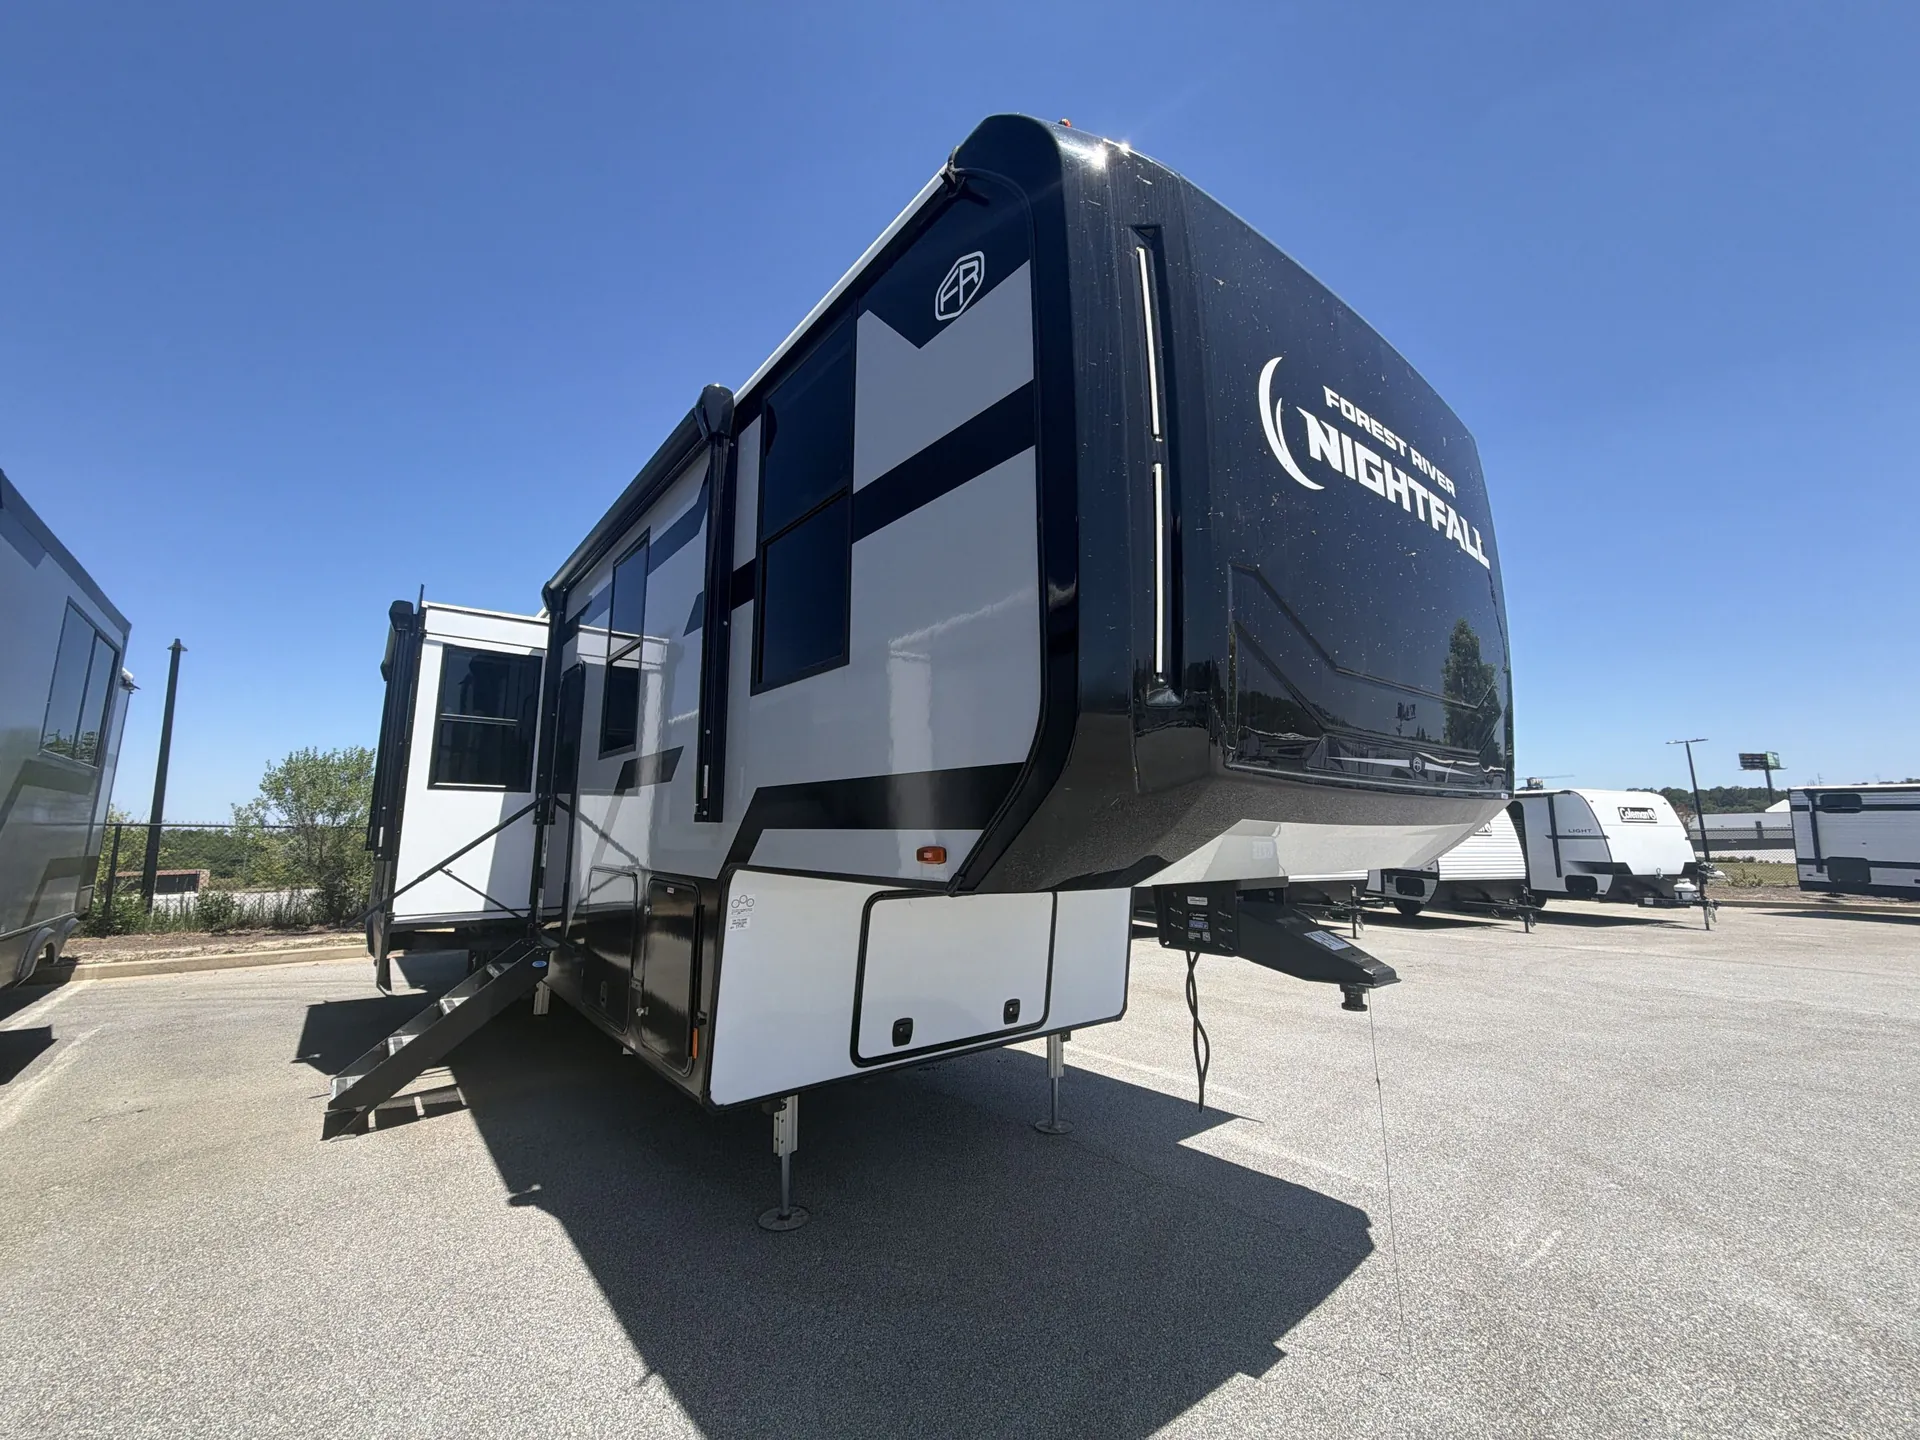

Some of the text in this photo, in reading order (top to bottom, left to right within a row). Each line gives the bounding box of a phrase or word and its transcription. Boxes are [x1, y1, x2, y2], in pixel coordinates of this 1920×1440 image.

[940, 260, 979, 312] FR
[1323, 385, 1456, 498] FOREST RIVER
[1296, 406, 1490, 570] NIGHTFALL
[1620, 806, 1650, 820] Coleman
